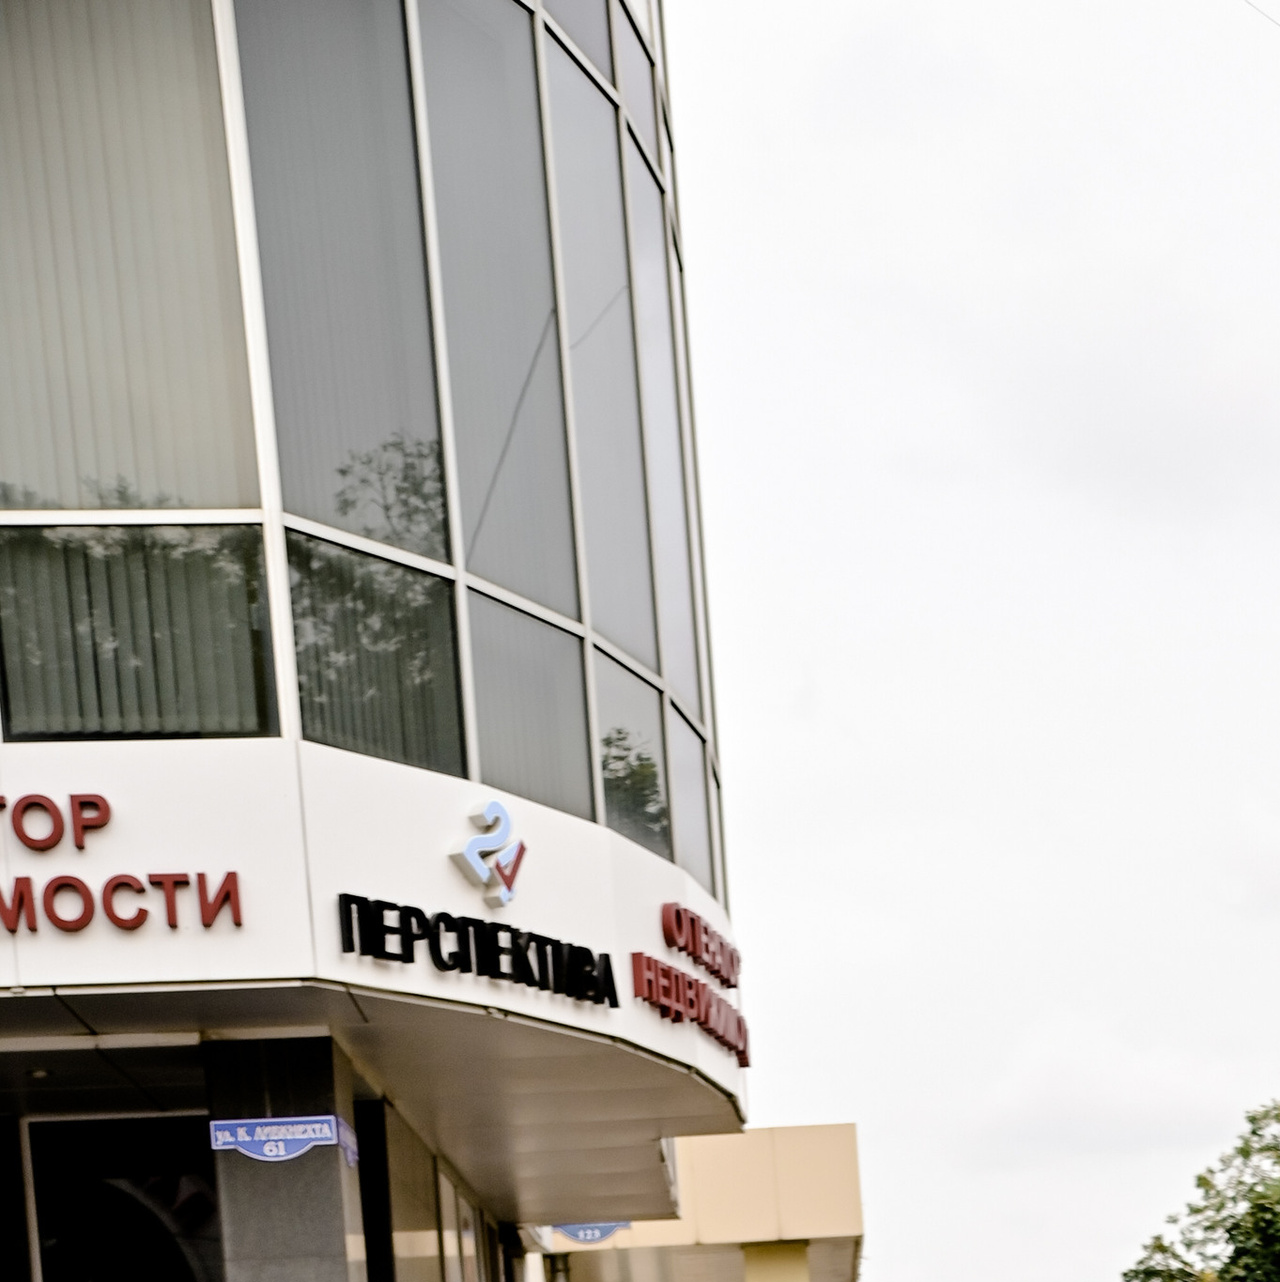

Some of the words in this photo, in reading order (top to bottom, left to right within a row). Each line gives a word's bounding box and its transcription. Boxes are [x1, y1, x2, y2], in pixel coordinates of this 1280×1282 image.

[0, 794, 111, 851] ОР
[339, 893, 619, 1008] ПЕРСПЕКТИВА
[263, 1141, 286, 1156] 61
